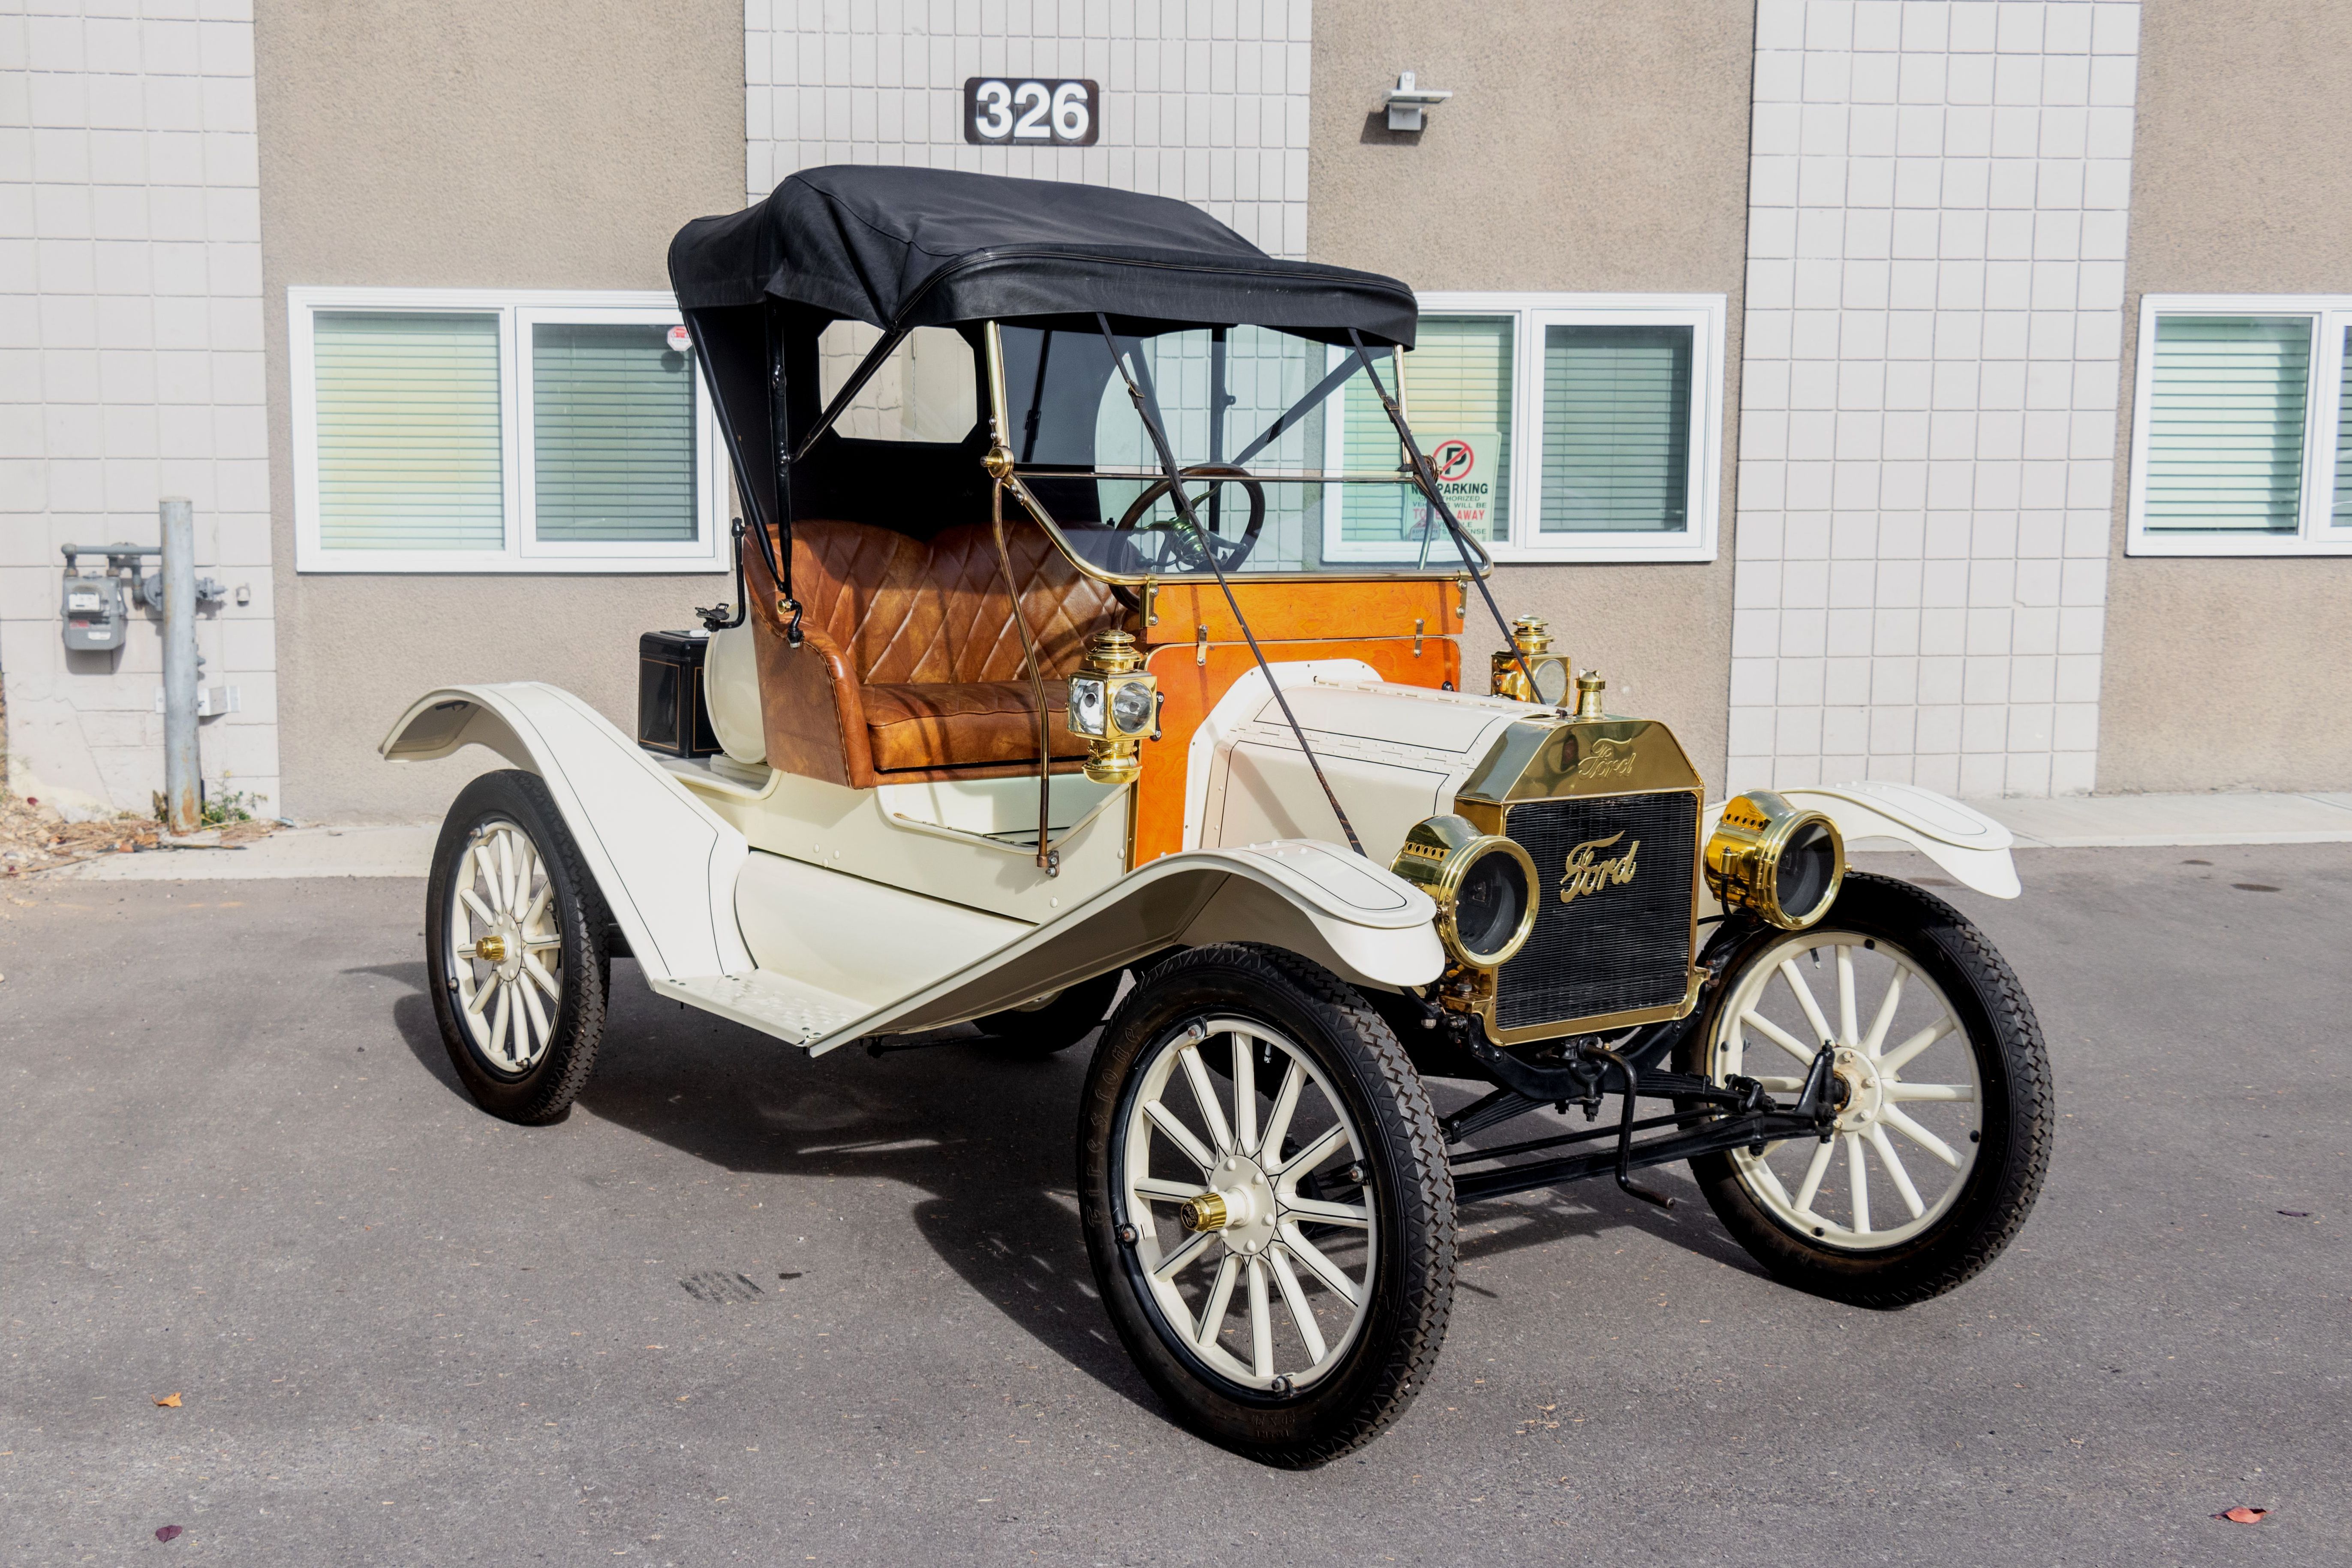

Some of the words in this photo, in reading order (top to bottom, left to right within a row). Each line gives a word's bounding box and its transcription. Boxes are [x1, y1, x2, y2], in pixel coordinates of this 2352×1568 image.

[976, 80, 1089, 140] 326
[1437, 483, 1488, 494] PARKING
[1457, 509, 1485, 520] AWAY
[1578, 737, 1636, 779] Ford
[1560, 830, 1640, 903] Ford
[1085, 1027, 1141, 1228] Firestone
